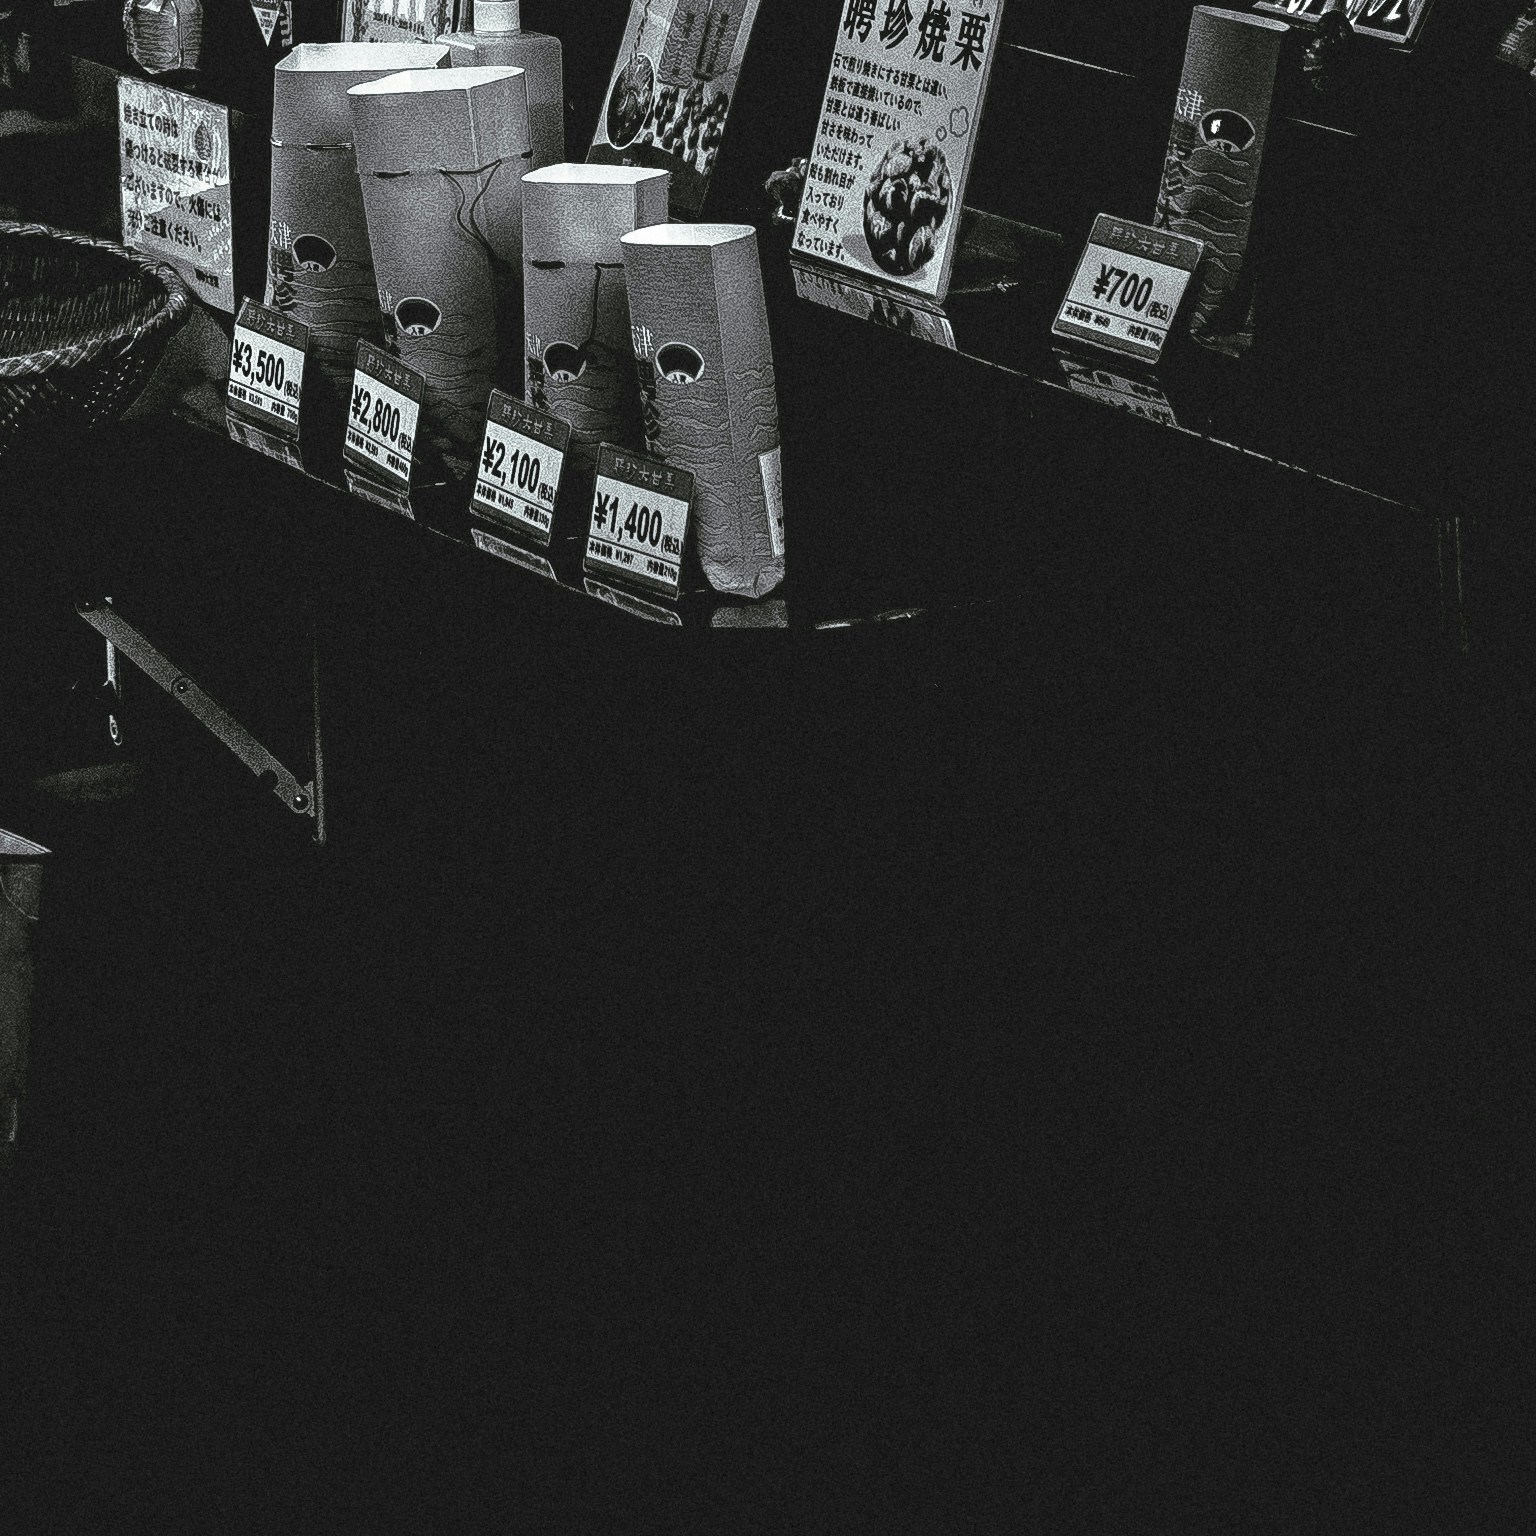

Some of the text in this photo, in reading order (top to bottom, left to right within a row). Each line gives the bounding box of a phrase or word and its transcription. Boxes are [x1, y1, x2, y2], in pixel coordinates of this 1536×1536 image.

[821, 119, 874, 148] 甘さを味わって
[816, 142, 864, 171] いただけます。
[805, 185, 845, 211] 入っており
[800, 208, 840, 234] 食べやすく
[797, 230, 845, 261] なっています。
[1092, 263, 1154, 313] ¥700
[232, 338, 285, 391] ¥3,500
[351, 384, 401, 444] ¥2,800
[482, 435, 541, 494] ¥2,100
[593, 490, 662, 548] ¥1,400
